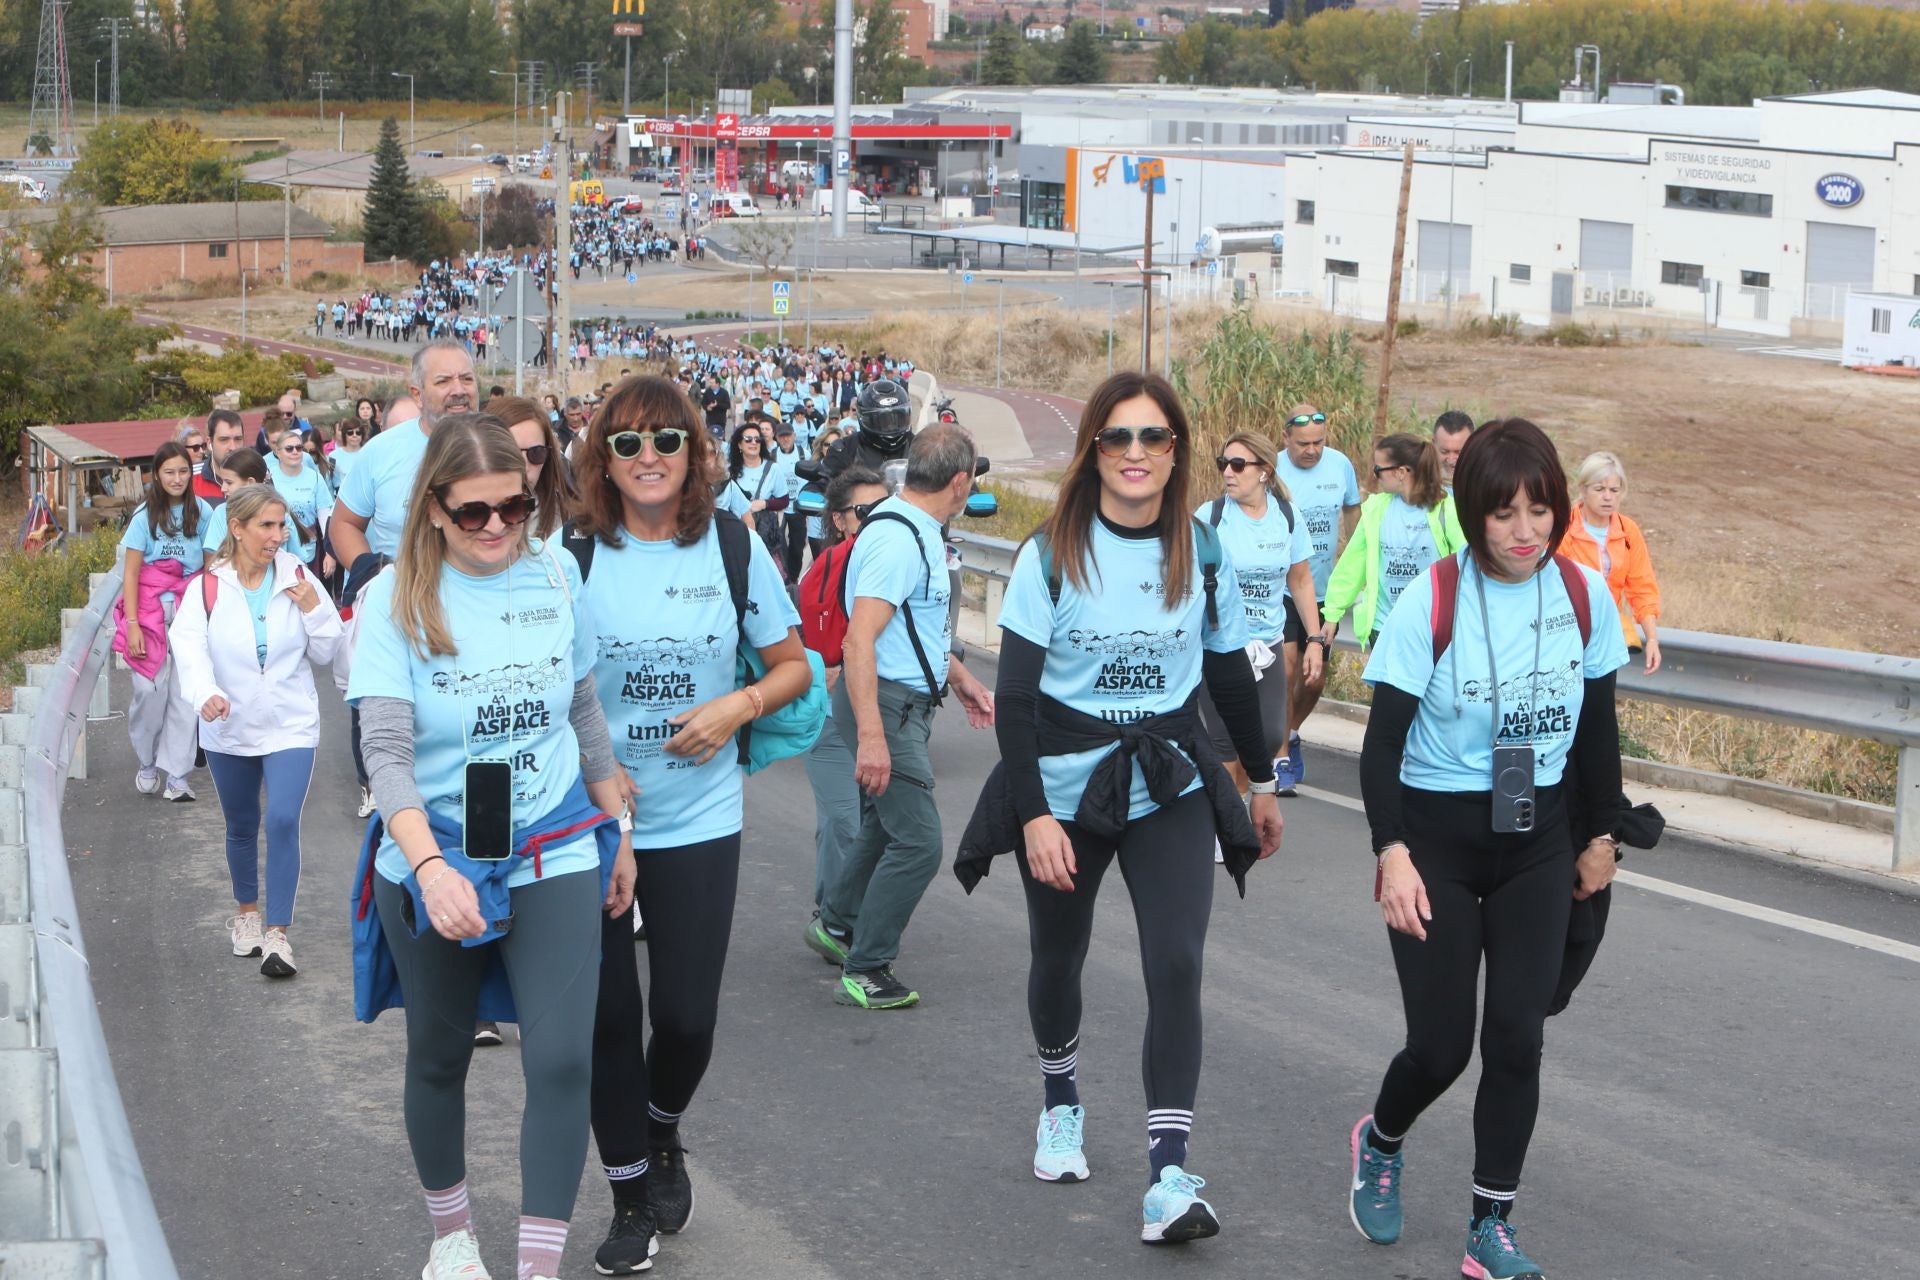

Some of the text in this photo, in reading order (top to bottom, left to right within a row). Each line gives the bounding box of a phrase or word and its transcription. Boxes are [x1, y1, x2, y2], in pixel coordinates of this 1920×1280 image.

[655, 123, 675, 133] CEPSA
[737, 126, 770, 136] CEPSA
[837, 151, 849, 168] P
[1664, 152, 1771, 170] SISTEMAS DE SEGURIDAD
[1676, 166, 1757, 184] Y VIDEOVIGILANCIA
[690, 192, 698, 206] P
[1825, 184, 1852, 202] 2000
[1386, 567, 1420, 576] ASPACE
[519, 616, 530, 624] DE
[625, 671, 691, 684] Marcha
[1100, 662, 1161, 676] Marcha
[1094, 675, 1166, 690] ASPACE
[621, 683, 696, 700] ASPACE
[477, 698, 545, 721] Marcha
[1503, 704, 1566, 726] Marcha
[471, 710, 550, 736] ASPACE
[1497, 714, 1572, 739] ASPACE
